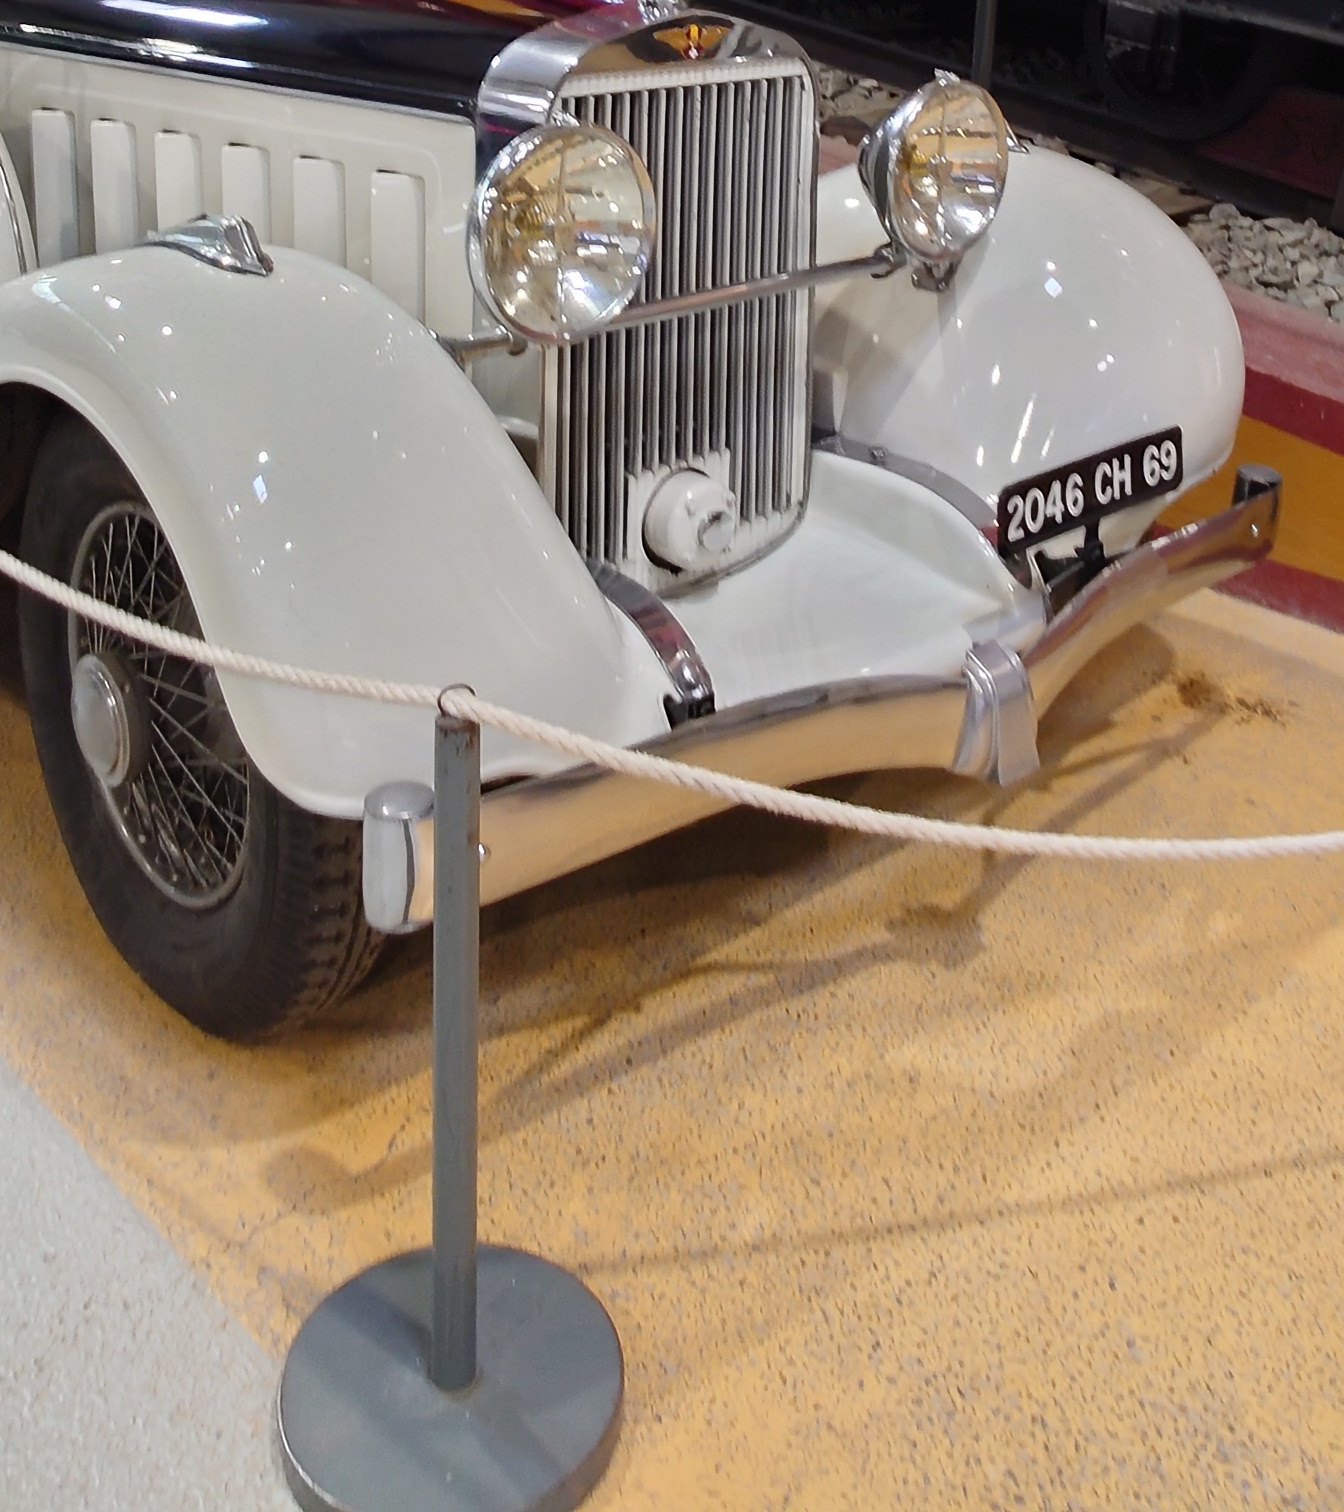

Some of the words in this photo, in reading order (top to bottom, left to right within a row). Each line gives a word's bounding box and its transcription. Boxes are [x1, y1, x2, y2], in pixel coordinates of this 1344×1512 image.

[1007, 473, 1084, 542] 2046
[1095, 454, 1132, 504] CH
[1143, 440, 1178, 486] 69
